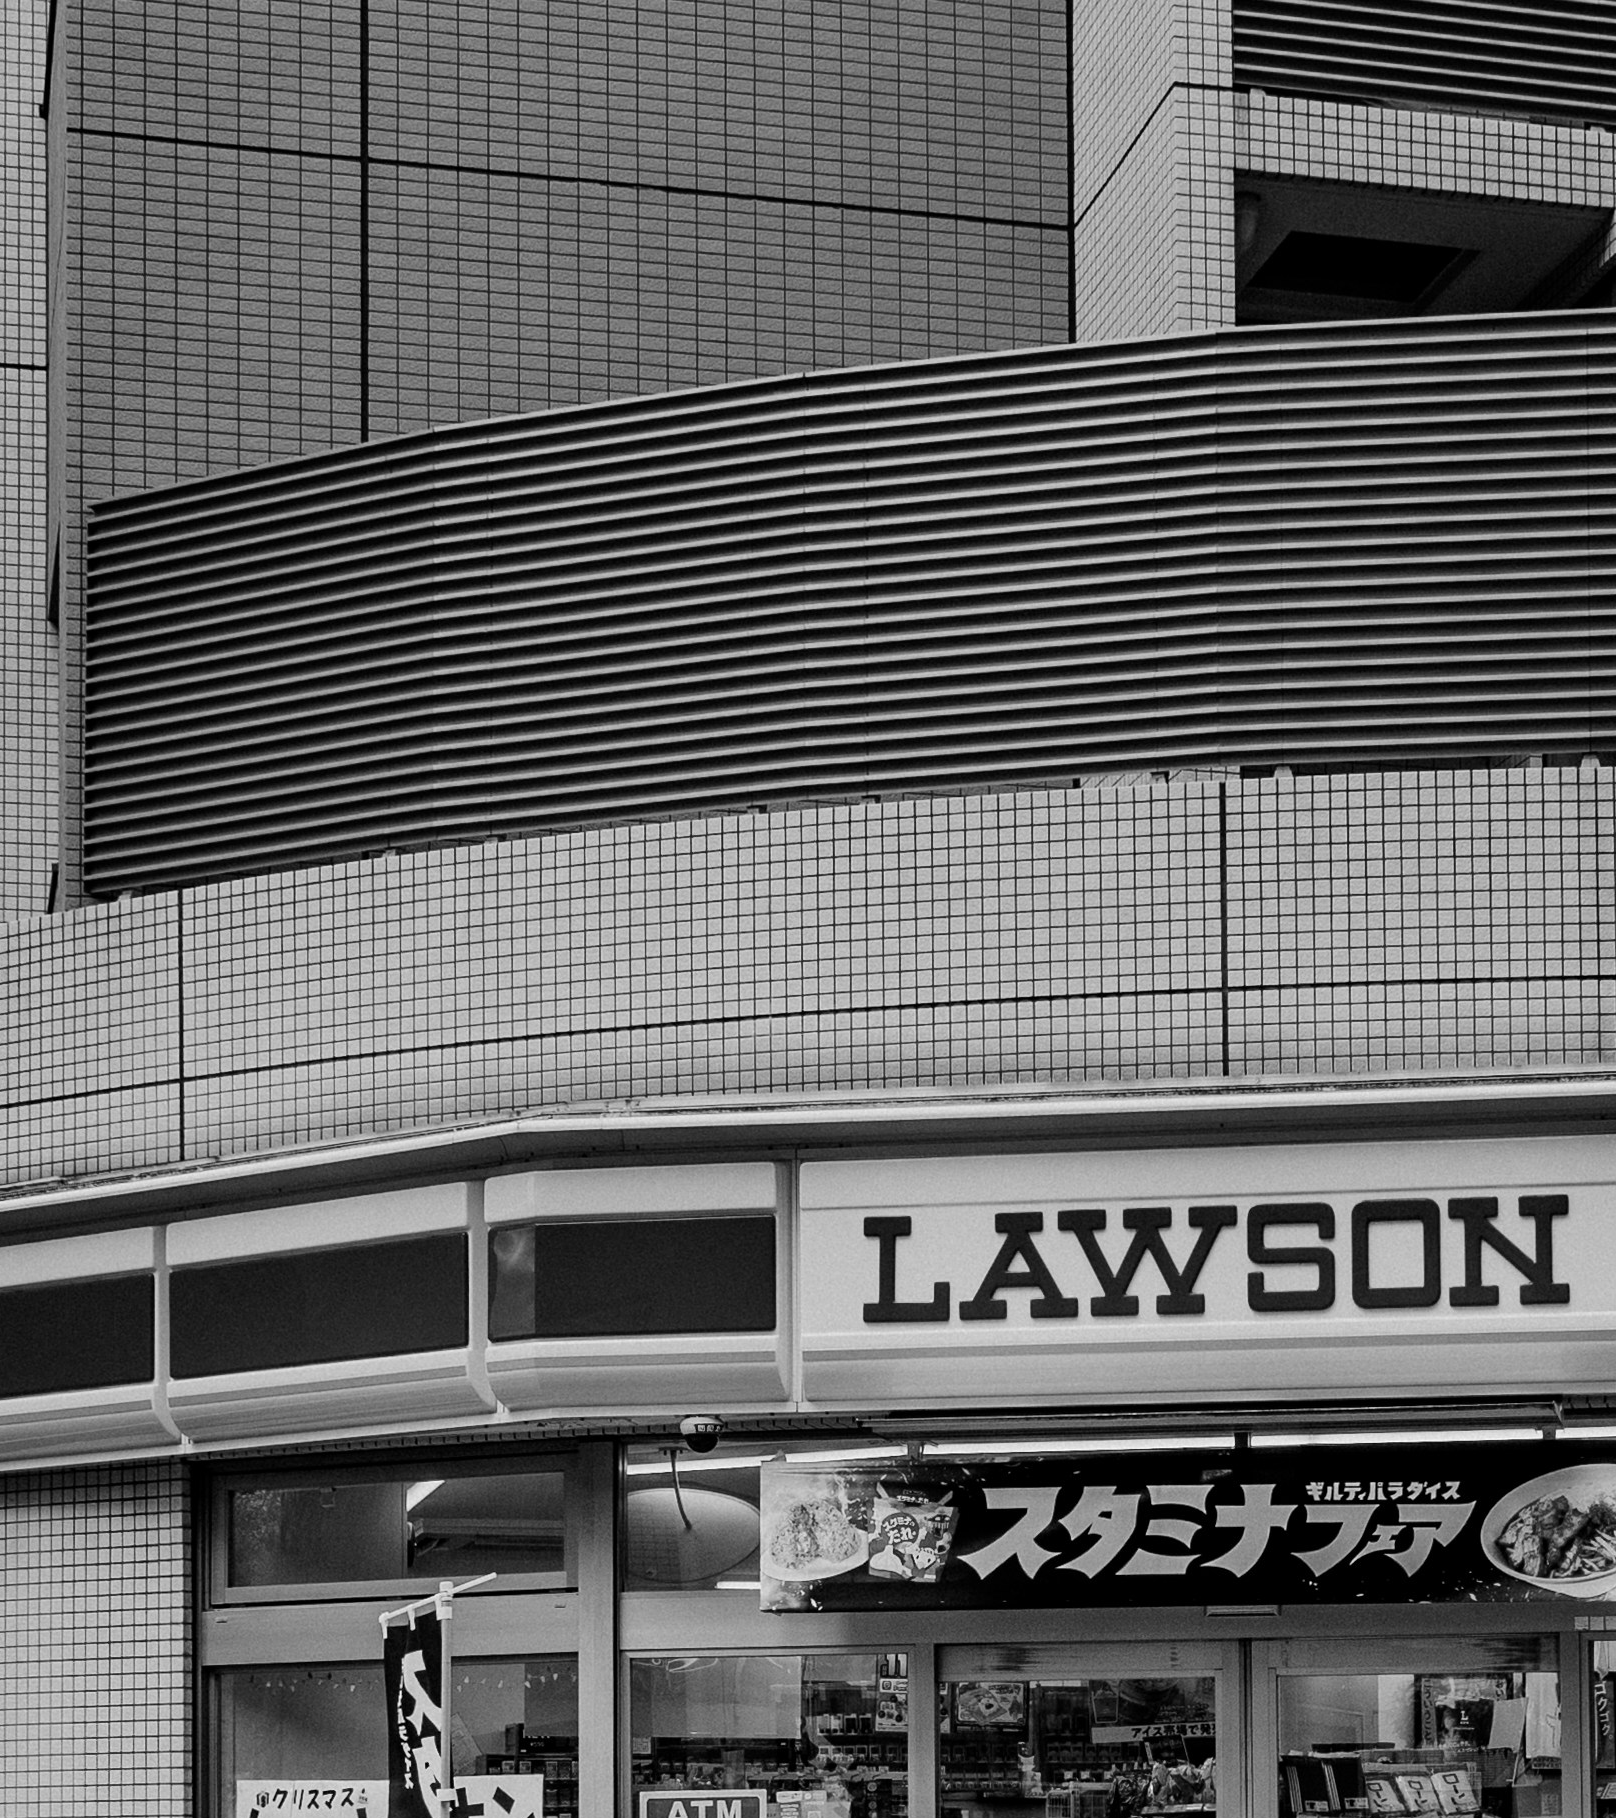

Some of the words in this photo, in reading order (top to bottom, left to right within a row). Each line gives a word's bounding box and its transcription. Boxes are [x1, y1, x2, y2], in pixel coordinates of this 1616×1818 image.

[863, 1194, 1571, 1323] LAWSON
[1305, 1481, 1462, 1501] ギルティパラダイス
[957, 1483, 1477, 1579] スタミナフェア
[272, 1788, 355, 1810] クリスマス
